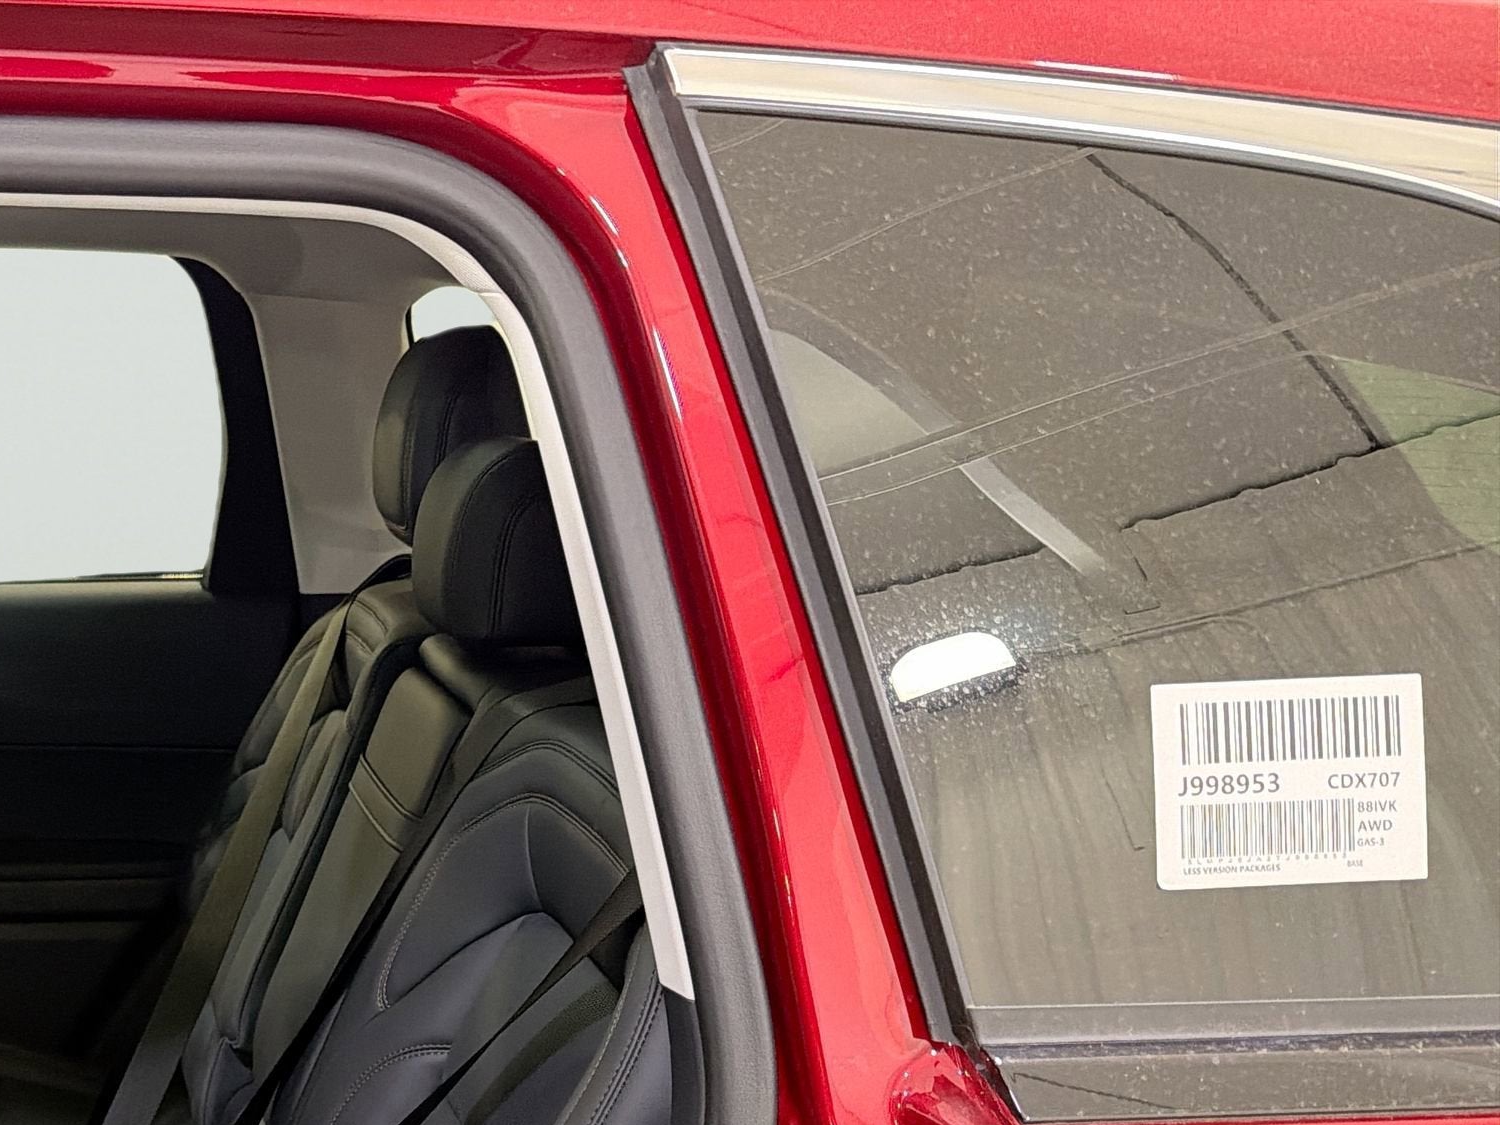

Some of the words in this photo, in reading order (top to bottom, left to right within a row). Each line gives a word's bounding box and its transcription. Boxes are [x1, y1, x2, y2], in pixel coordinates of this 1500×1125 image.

[1178, 772, 1281, 797] J998953
[1328, 772, 1401, 789] CDX707
[1357, 819, 1393, 832] AWD
[1357, 837, 1385, 848] GAS-3
[1183, 866, 1201, 876] LESS
[1203, 865, 1238, 874] VERSION
[1240, 863, 1281, 873] PACKAGES
